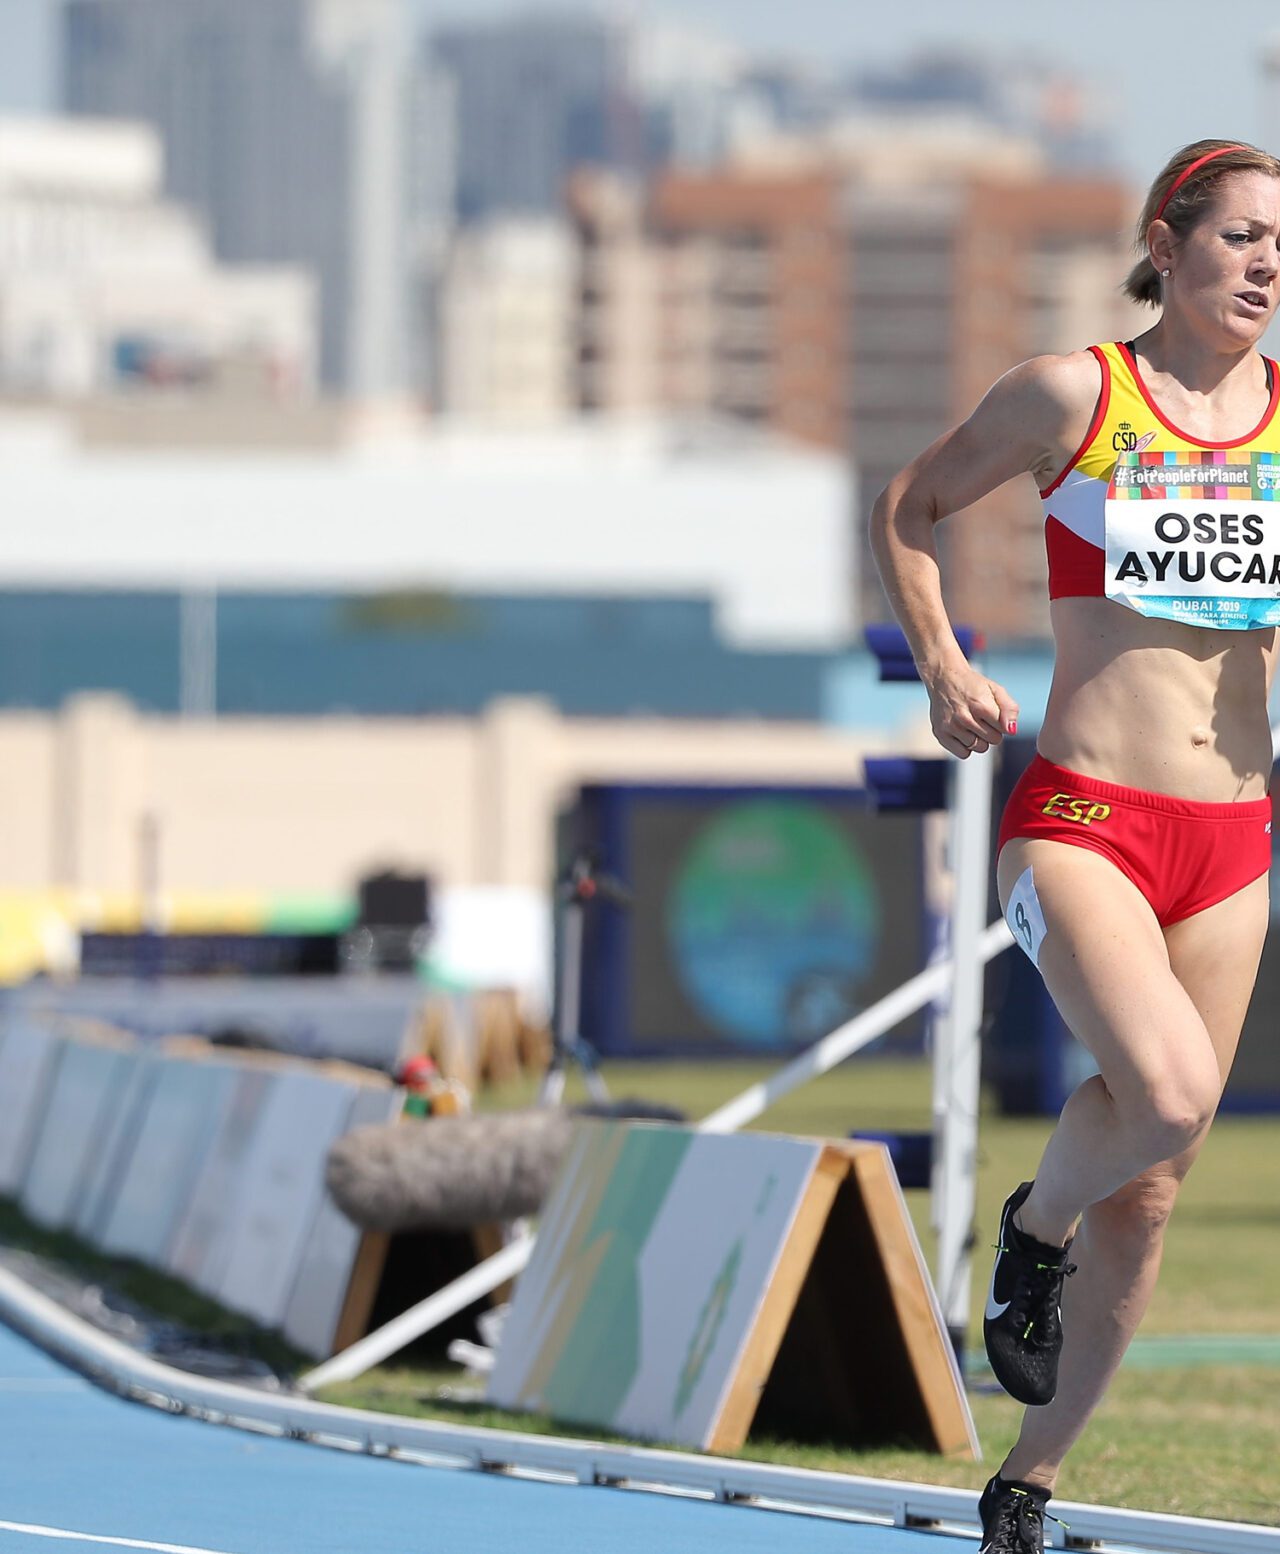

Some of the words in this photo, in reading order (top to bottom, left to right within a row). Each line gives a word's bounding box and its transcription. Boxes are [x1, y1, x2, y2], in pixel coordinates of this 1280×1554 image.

[1112, 432, 1137, 452] CSD
[1115, 467, 1249, 486] #ForPeopleForPlanet
[1154, 512, 1264, 546] OSES
[1172, 601, 1213, 611] DUBAI
[1217, 601, 1240, 612] 2019
[1220, 612, 1248, 620] ATHLETICS
[1042, 793, 1111, 826] ESP
